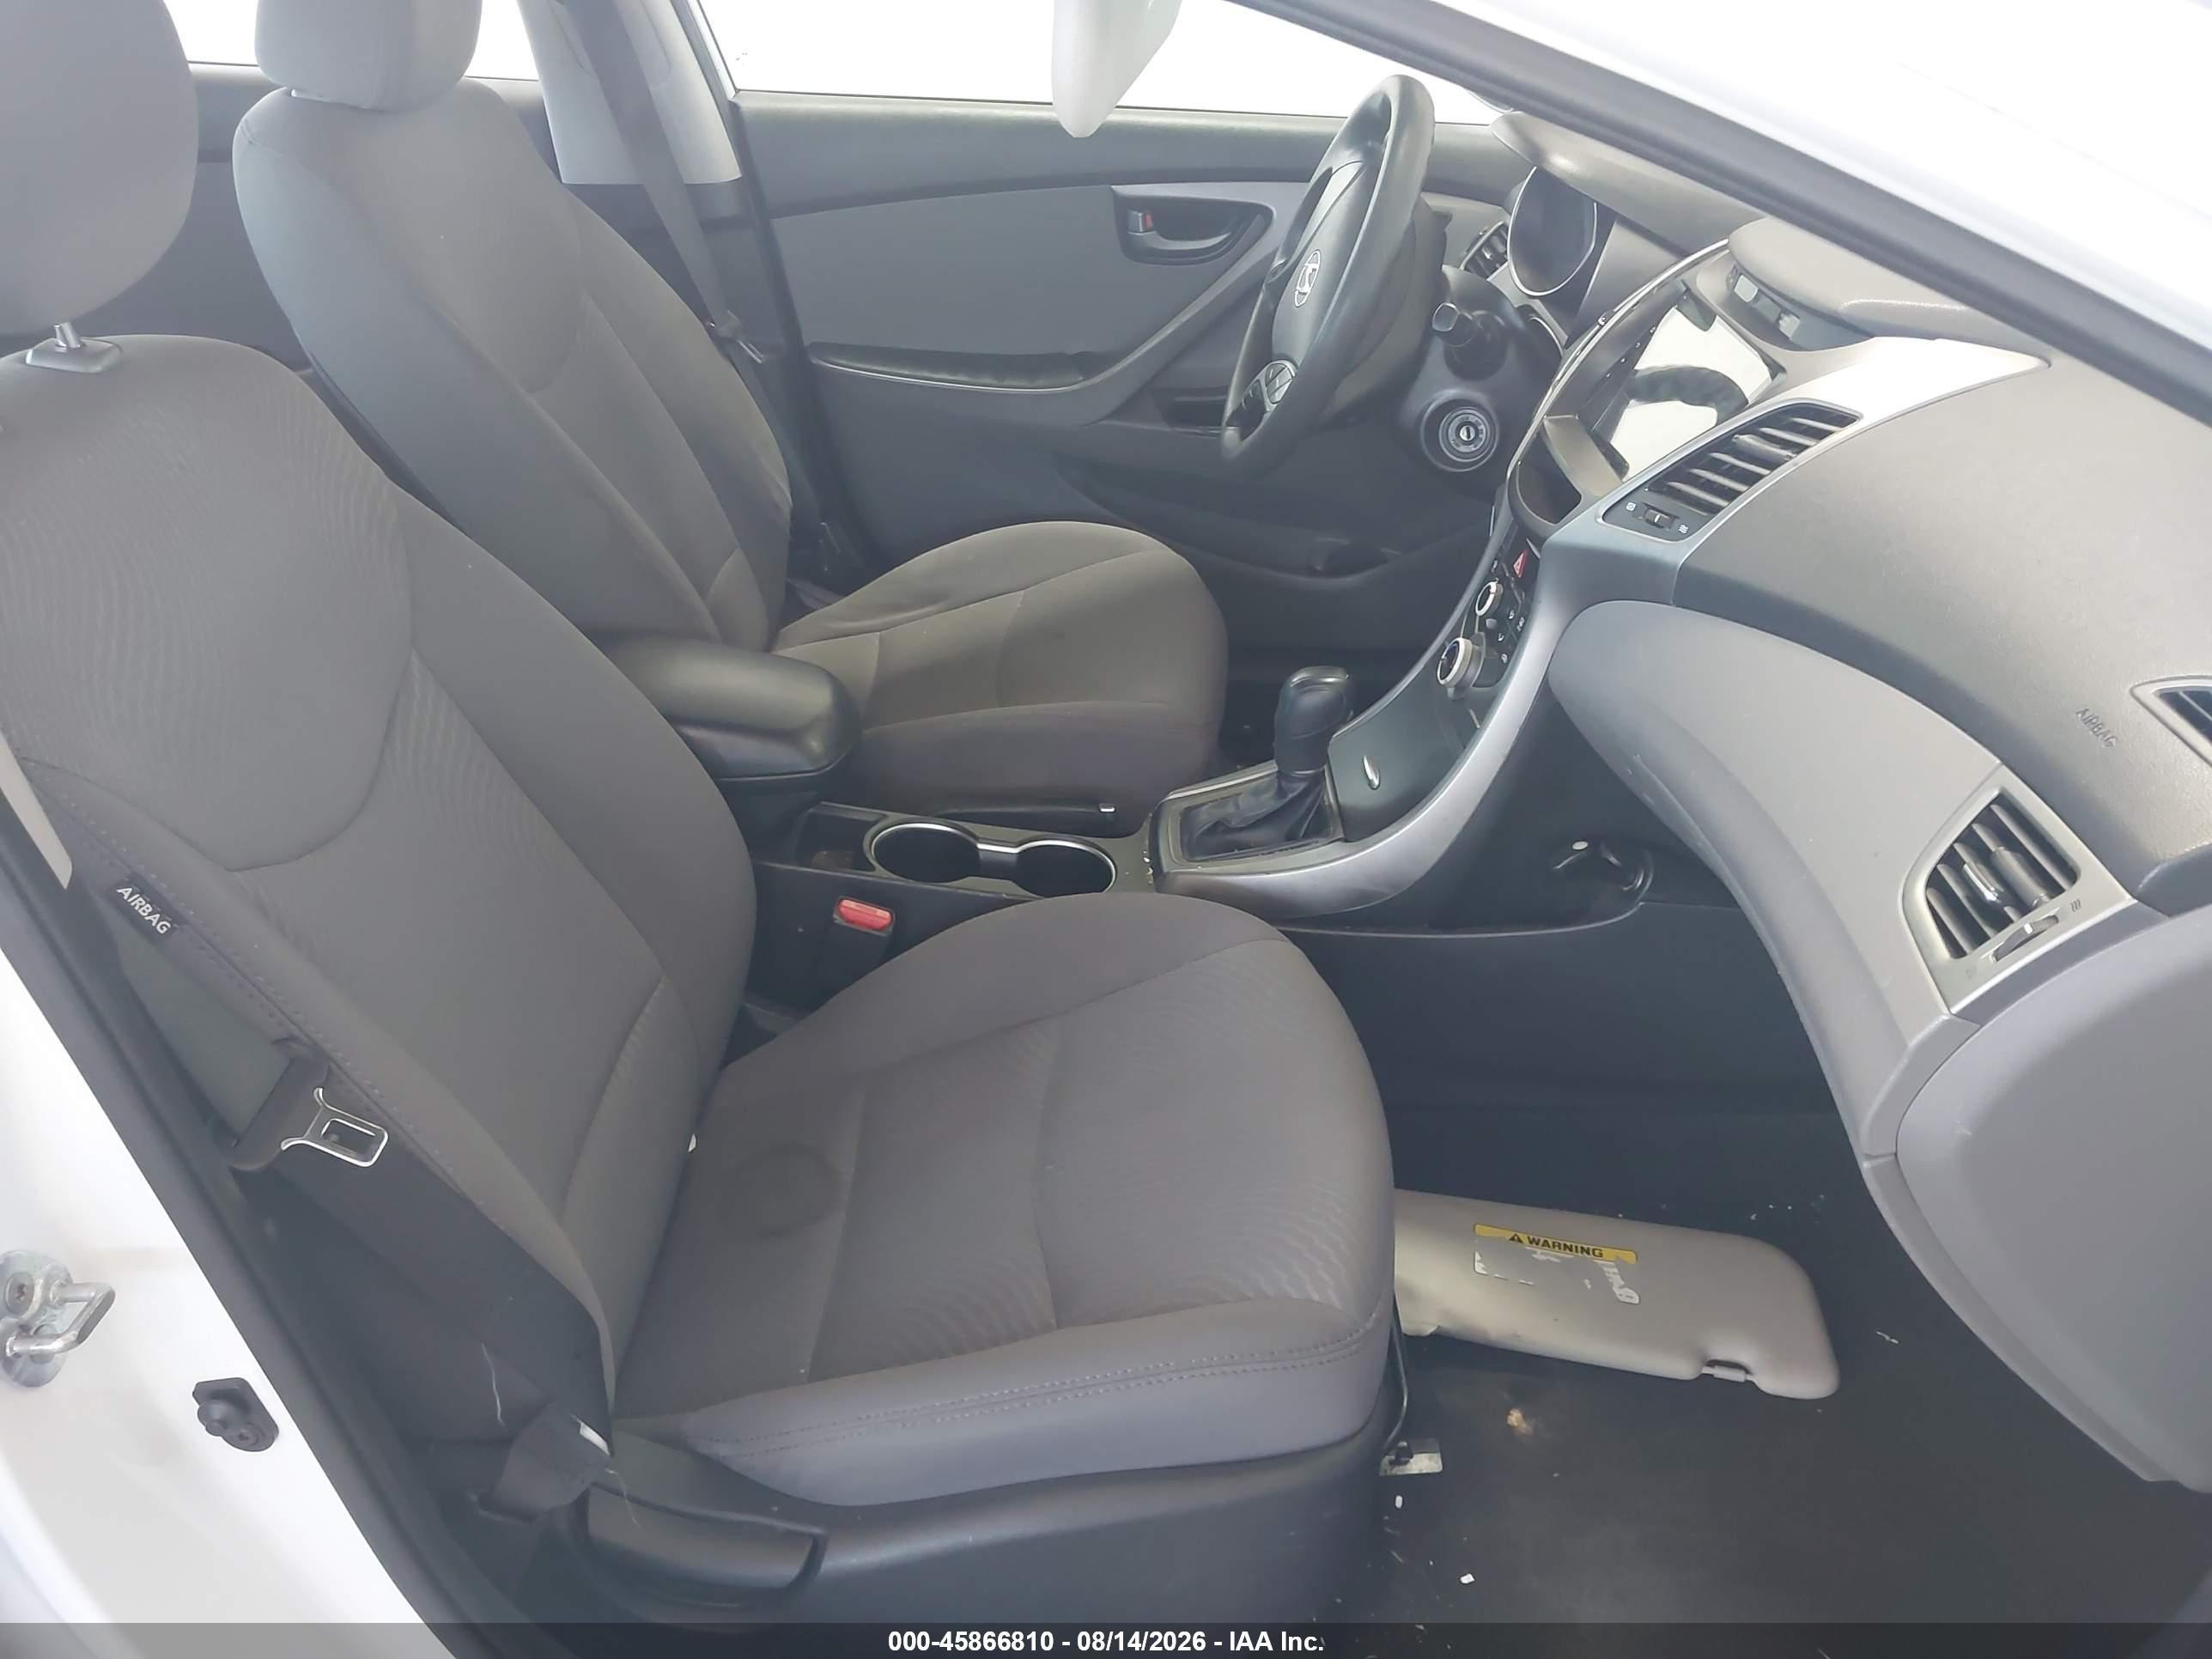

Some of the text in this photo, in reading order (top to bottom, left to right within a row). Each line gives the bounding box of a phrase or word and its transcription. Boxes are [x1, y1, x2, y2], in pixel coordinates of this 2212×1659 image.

[2075, 708, 2118, 748] AIRBAG
[116, 886, 172, 934] AIRBAG
[1527, 1236, 1604, 1259] WARNING
